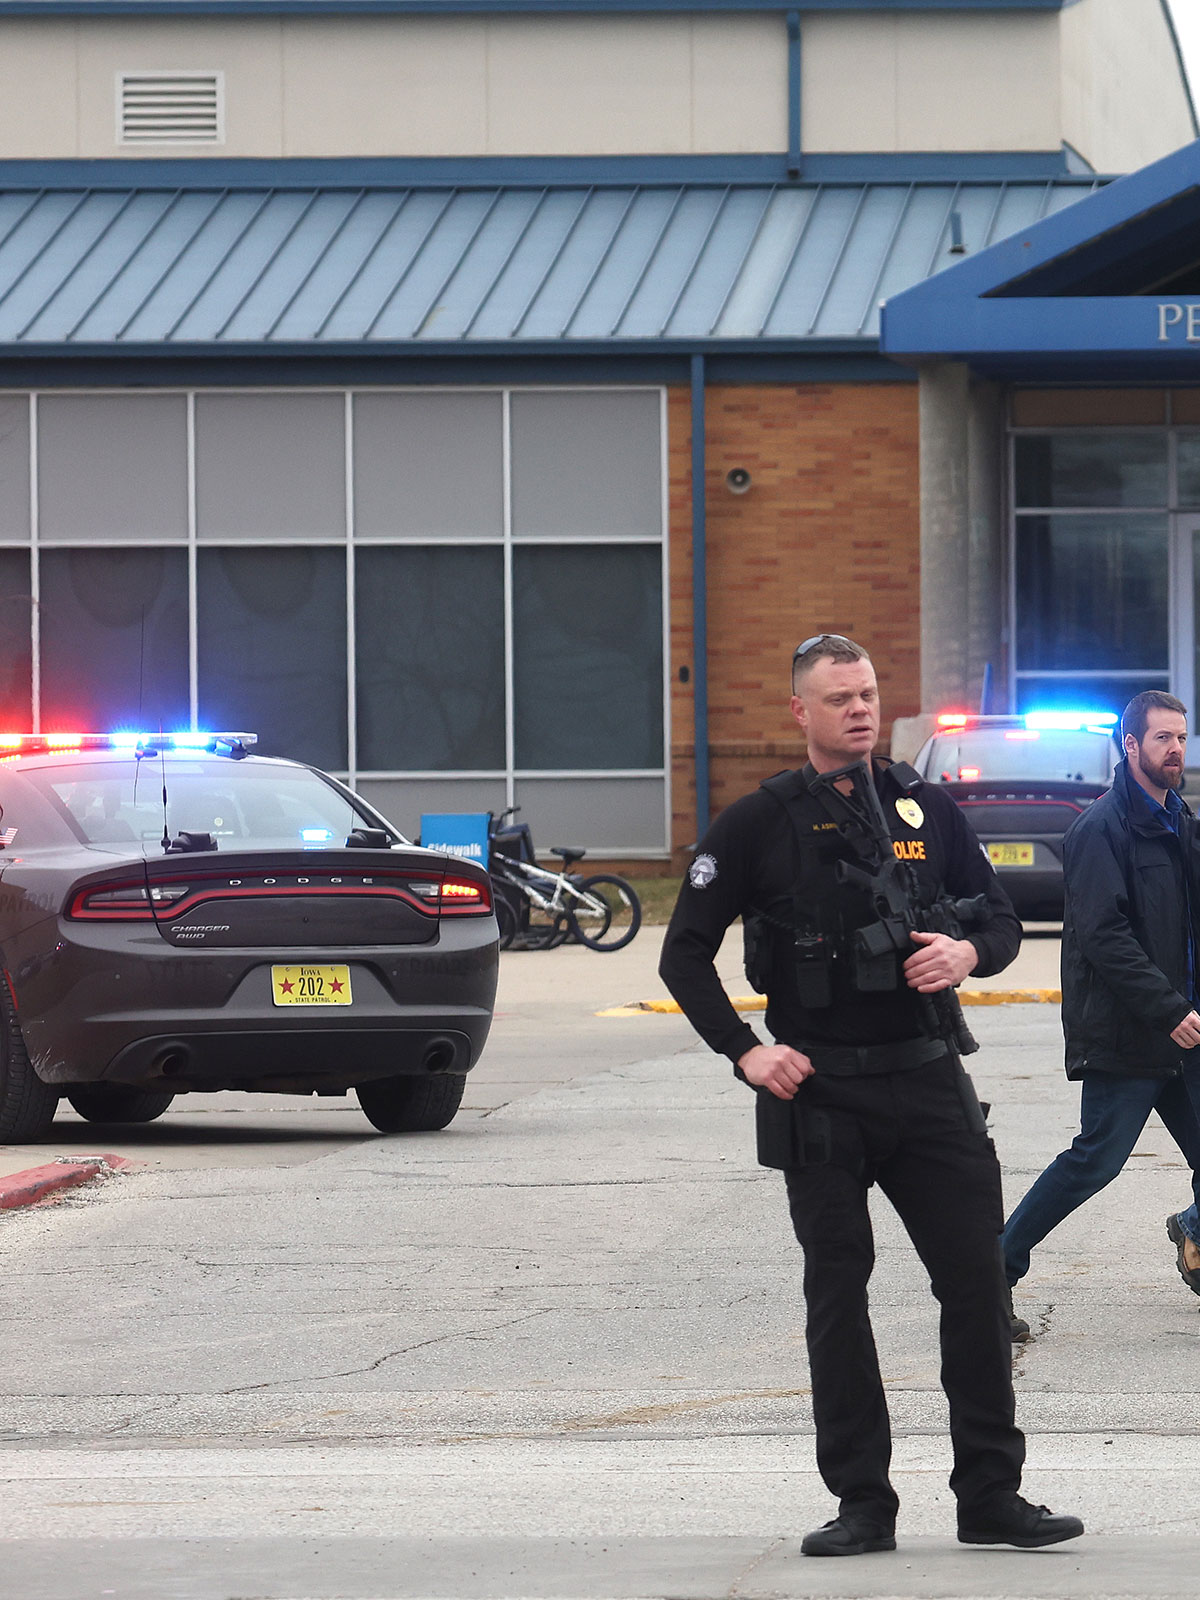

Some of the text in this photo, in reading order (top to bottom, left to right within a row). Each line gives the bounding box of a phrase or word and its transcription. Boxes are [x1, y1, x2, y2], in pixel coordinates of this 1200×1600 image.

[893, 841, 926, 860] OLICE
[229, 877, 373, 886] DODGE
[298, 977, 325, 996] 202
